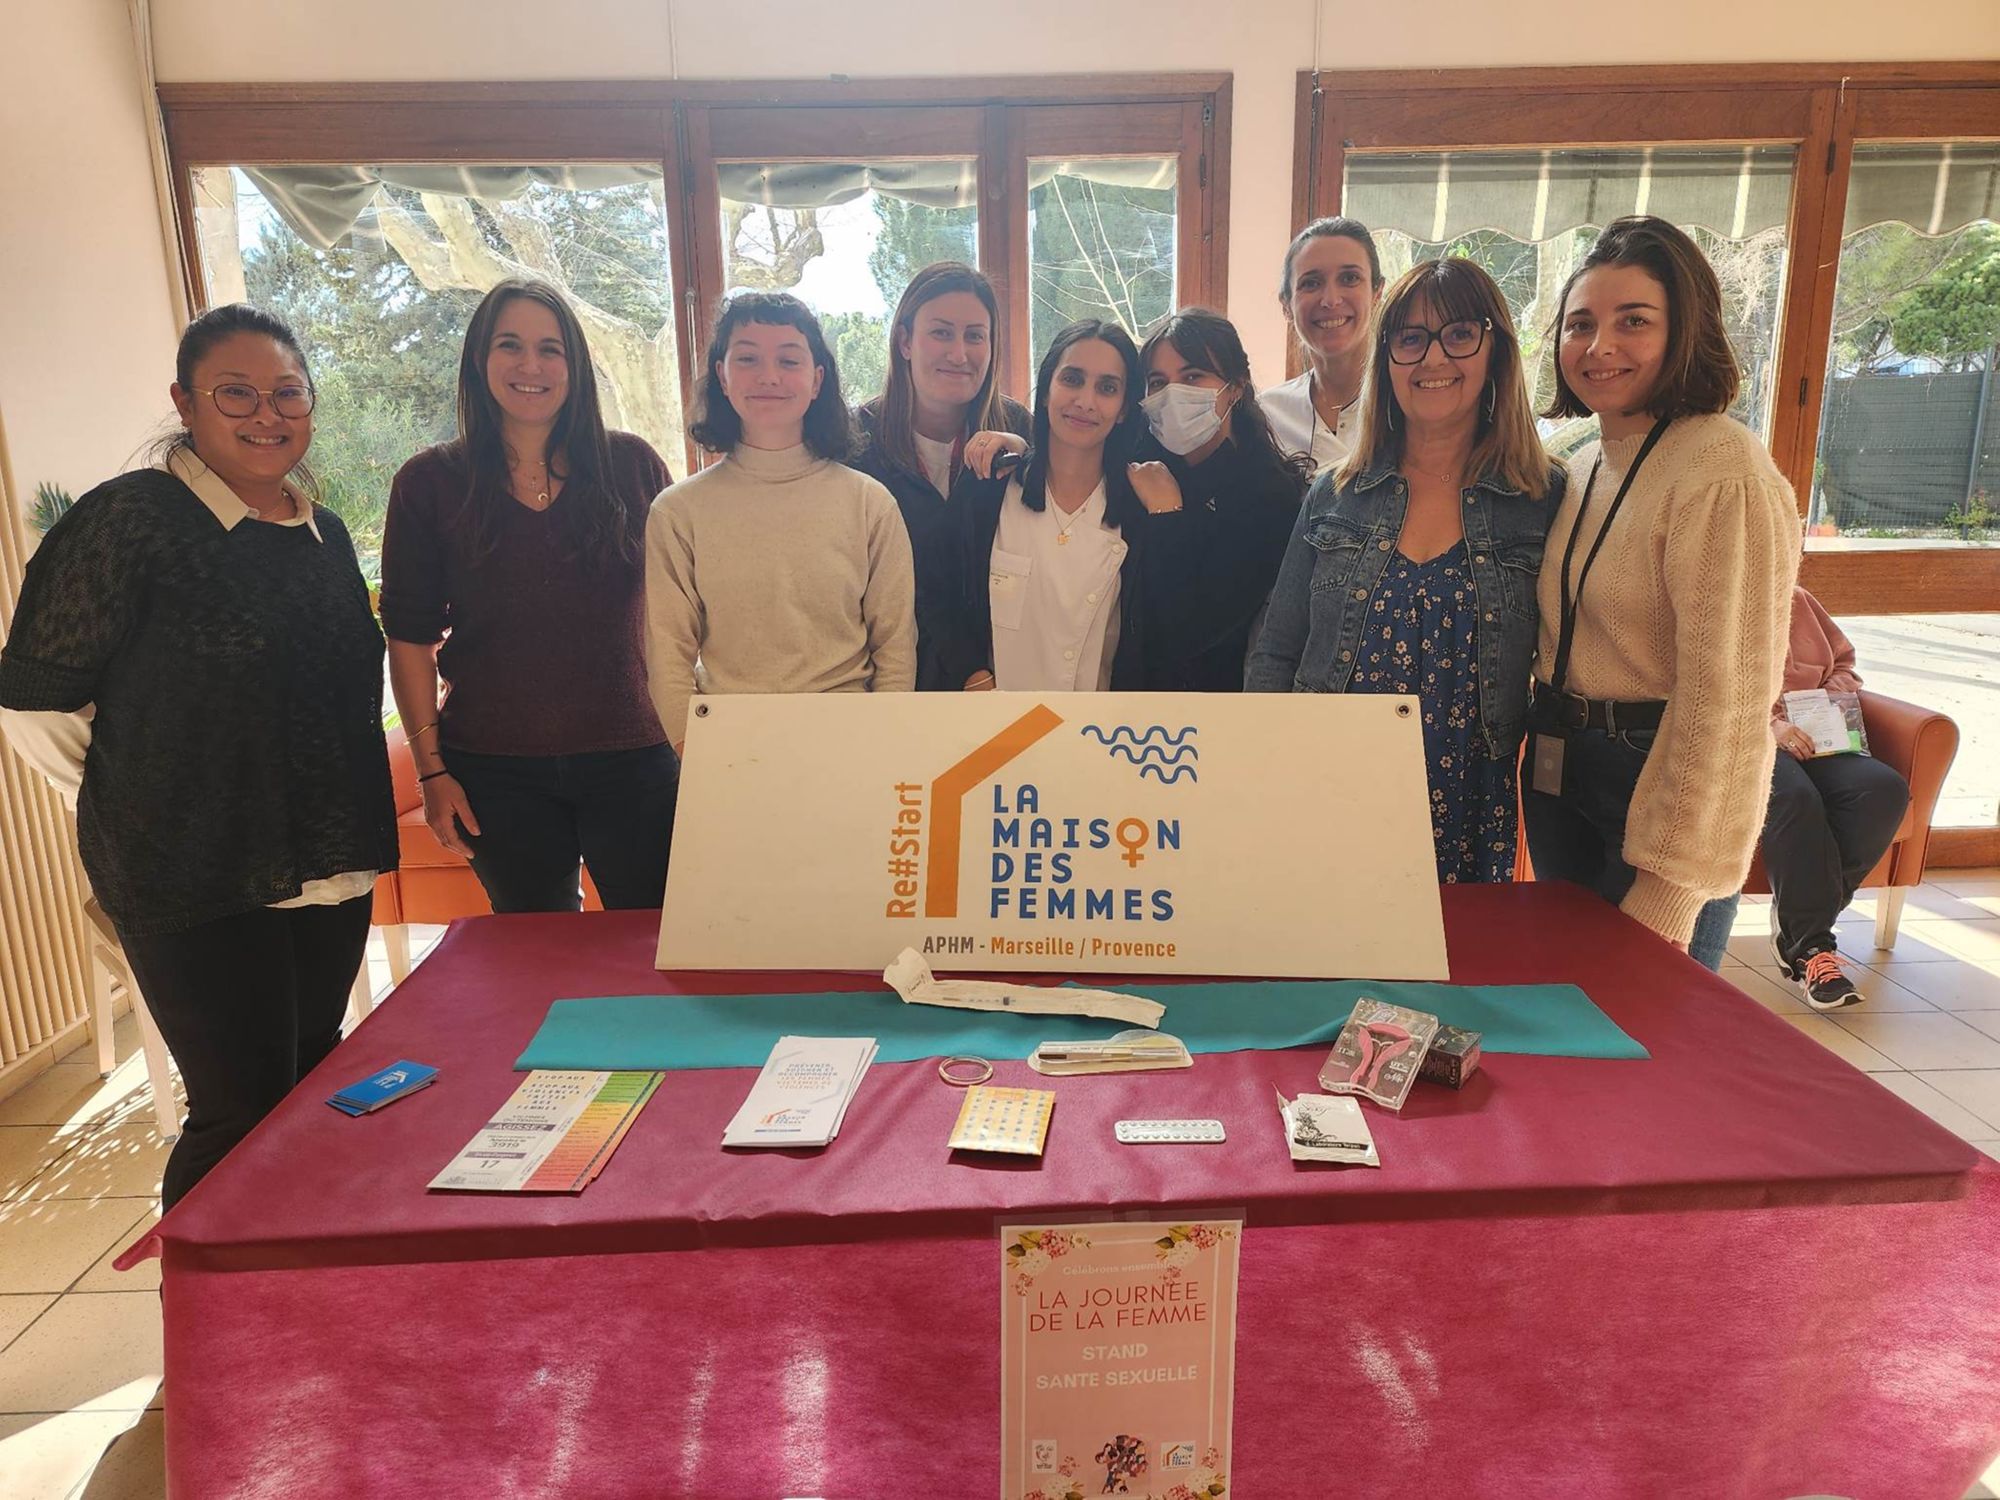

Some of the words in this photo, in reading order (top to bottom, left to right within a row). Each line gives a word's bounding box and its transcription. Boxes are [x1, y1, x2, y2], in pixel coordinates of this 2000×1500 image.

[993, 784, 1039, 814] LA
[886, 782, 923, 918] Re#Start
[992, 817, 1181, 869] MAISON
[991, 852, 1073, 884] DES
[990, 887, 1174, 921] FEMMES
[923, 936, 975, 954] APHM
[991, 936, 1075, 956] Marseille
[1092, 938, 1176, 957] Provence
[480, 1160, 500, 1168] 17
[1039, 1291, 1068, 1310] LA
[1030, 1313, 1063, 1332] DE
[1076, 1310, 1104, 1330] LA
[1116, 1303, 1206, 1328] FEMME
[1082, 1343, 1148, 1361] STAND
[1036, 1372, 1099, 1390] SANTE
[1105, 1365, 1198, 1387] SEXUELLE
